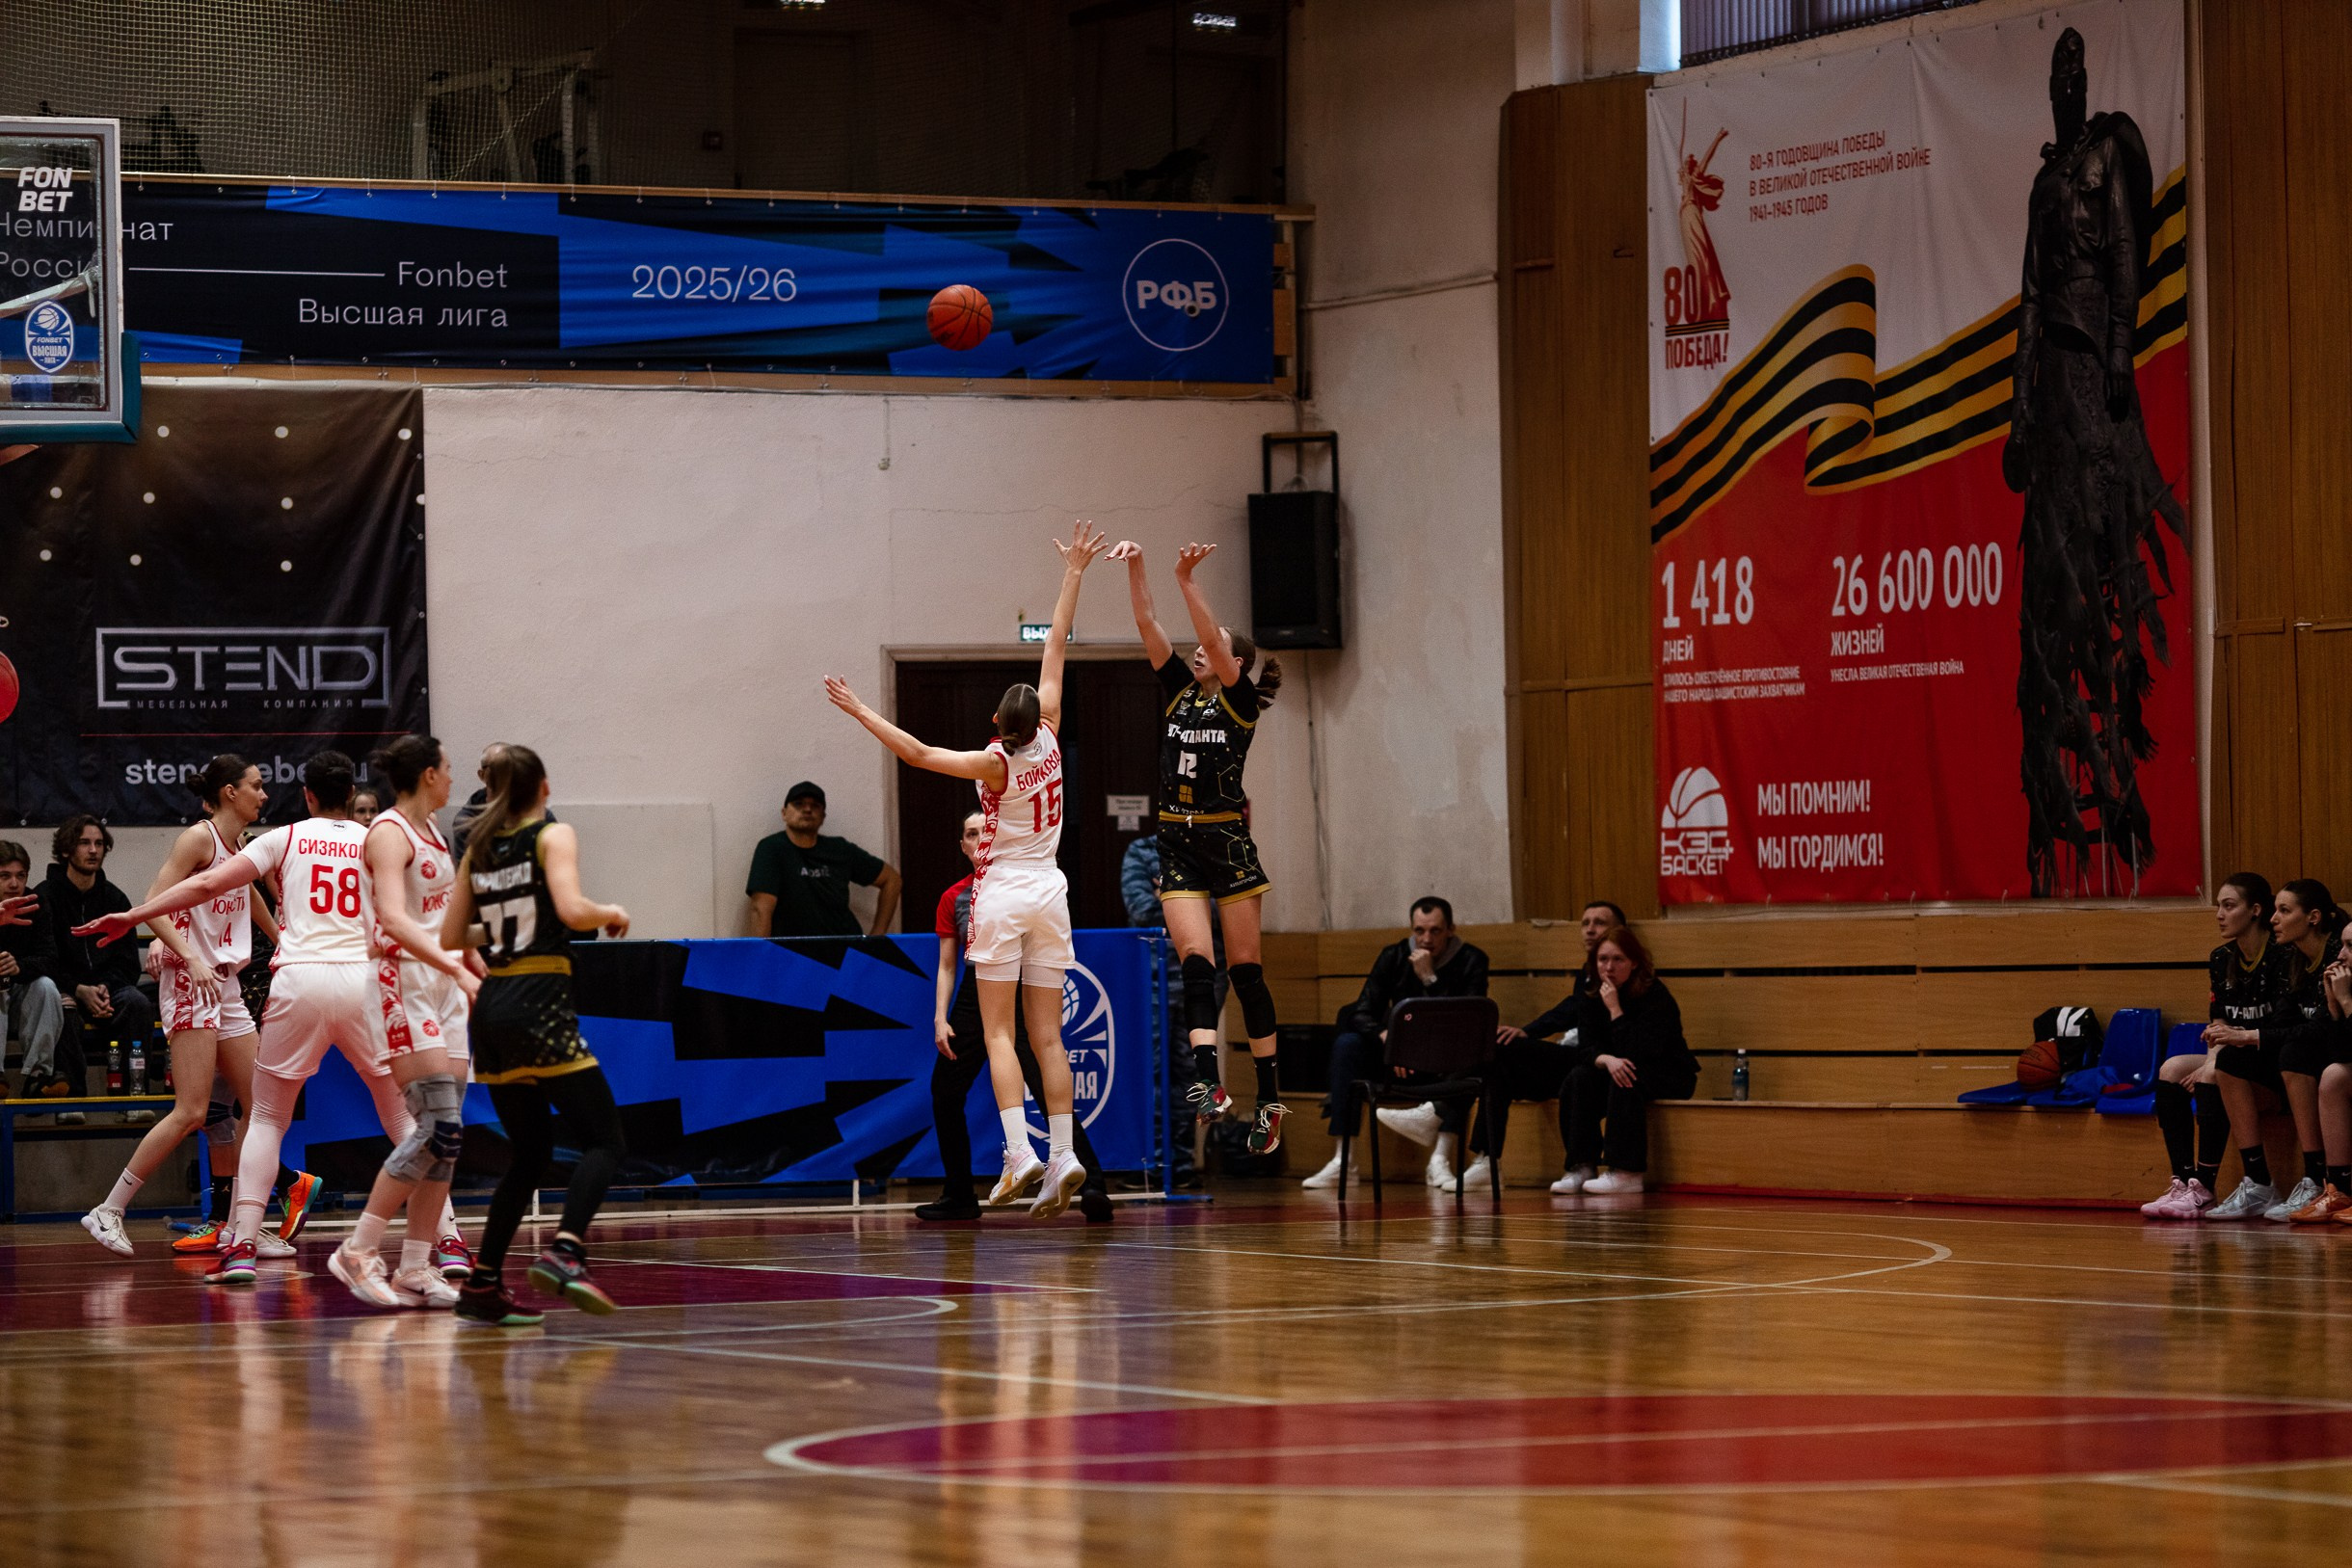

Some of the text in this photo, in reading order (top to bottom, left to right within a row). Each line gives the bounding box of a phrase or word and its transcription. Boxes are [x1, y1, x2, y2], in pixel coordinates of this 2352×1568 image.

[1750, 130, 1885, 172] 80-Я ГОДОВЩИНА ПОБЕДЫ
[17, 167, 73, 188] FON
[1750, 146, 1932, 197] В ВЕЛИКОЙ ОТЕЧЕСТВЕННОЙ ВОЙНЕ
[17, 191, 73, 212] BET
[1795, 194, 1829, 217] ГОДОВ
[0, 211, 174, 241] Чемпинат
[397, 261, 508, 288] Fonbet
[631, 264, 797, 303] 2025/26
[1137, 279, 1216, 310] РФБ
[1664, 264, 1699, 326] 80
[299, 299, 508, 329] Высшая лига
[32, 345, 67, 357] ВЫСШАЯ
[1666, 332, 1729, 370] ПОБЕДА!
[1661, 556, 1754, 628] 1 418
[1832, 542, 2003, 617] 26 600 000
[1831, 623, 1884, 657] ЖИЗНЕЙ
[114, 645, 378, 691] STEND
[1939, 658, 1964, 675] ВОЙНА
[137, 699, 353, 709] МЕБЕЛЬНАЯ КОМПАНИЯ
[1016, 749, 1060, 791] БОЙКОВА
[1028, 777, 1062, 834] 15
[1757, 779, 1871, 816] МЫ ПОМНИМ!
[299, 838, 362, 860] СИЗЯКО
[1661, 854, 1725, 876] БАСКЕТ
[1757, 834, 1884, 873] МЫ ГОРДИМСЯ!
[309, 864, 361, 917] 58
[479, 895, 536, 954] 77
